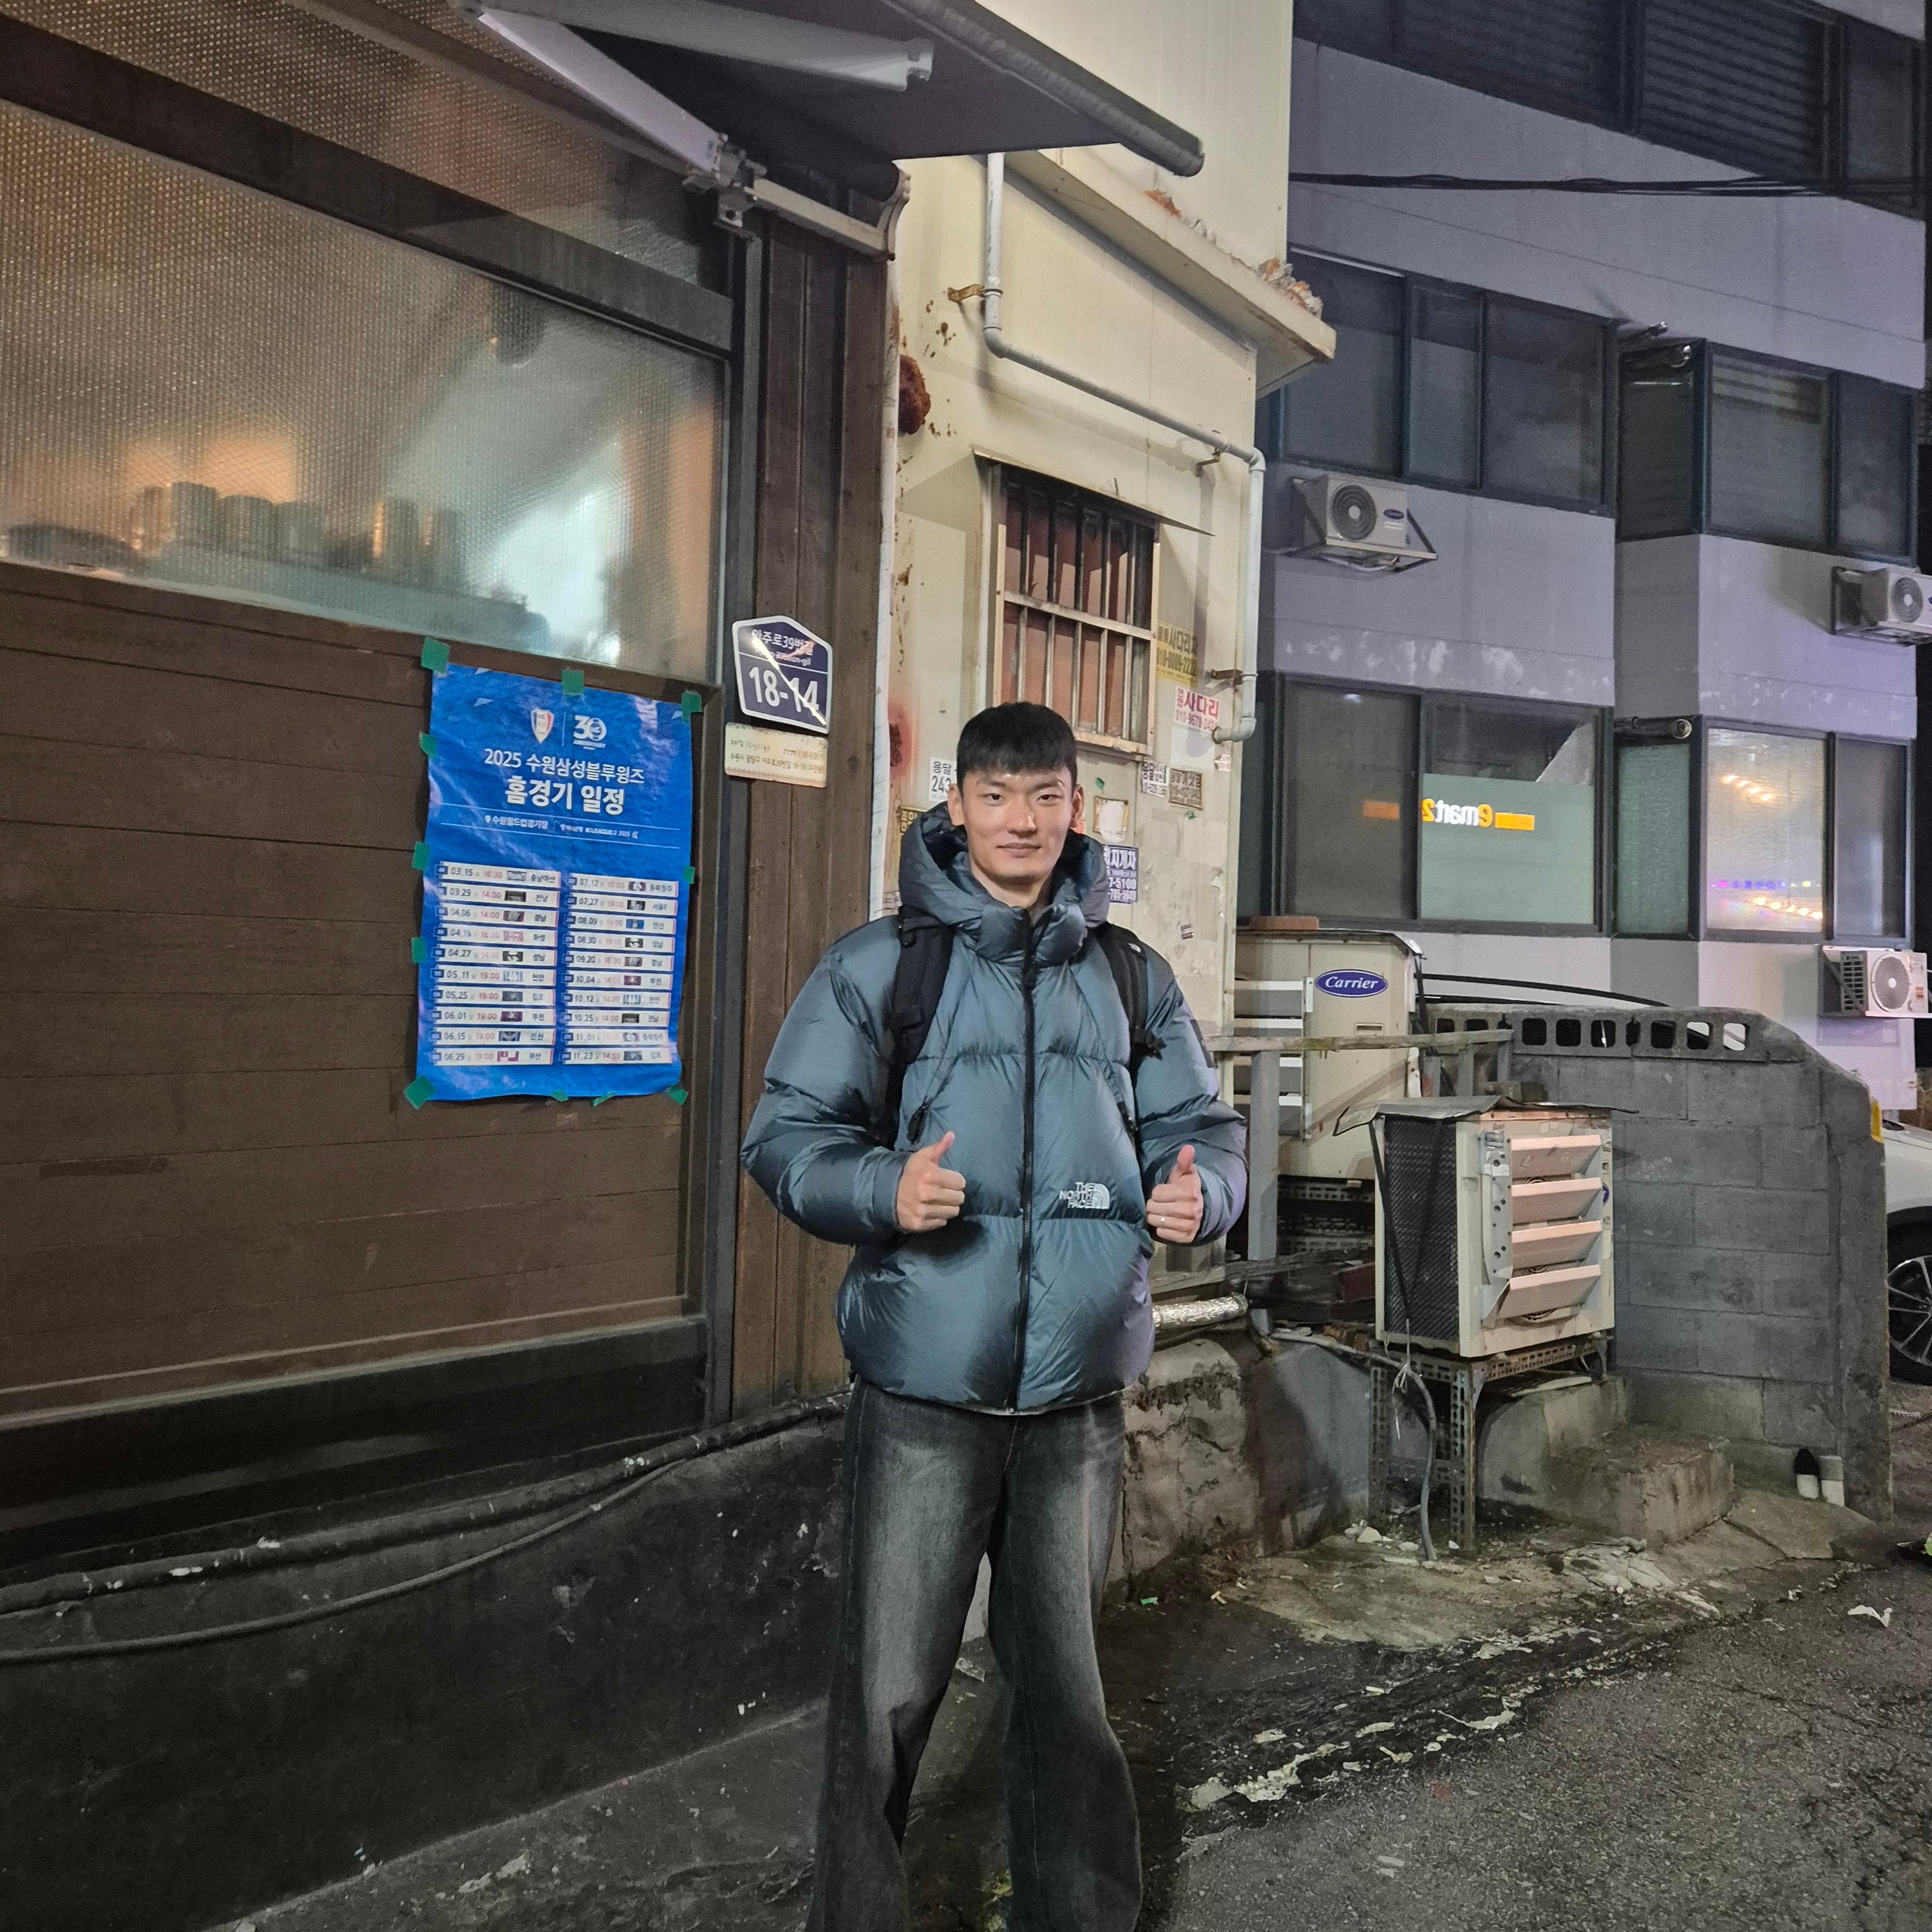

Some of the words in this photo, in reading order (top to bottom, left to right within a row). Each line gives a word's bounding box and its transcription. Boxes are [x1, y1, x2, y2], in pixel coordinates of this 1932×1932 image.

[749, 667, 819, 713] 18-14
[1184, 691, 1219, 719] 사다리
[484, 748, 522, 768] 2025
[526, 753, 645, 784] 수원삼성블루윙즈
[933, 761, 952, 775] 용달
[505, 775, 573, 810] 홈경기
[581, 786, 625, 815] 일정
[451, 867, 473, 876] 03.15
[484, 870, 502, 878] 16:30
[450, 887, 471, 896] 03.29
[482, 891, 501, 899] 14:00
[451, 928, 471, 937] 04.19
[448, 949, 471, 957] 04.27
[576, 955, 596, 963] 09.20
[447, 971, 469, 979] 05.11
[1325, 976, 1378, 989] Carrier
[1075, 1182, 1094, 1191] THE
[1059, 1190, 1092, 1200] NORTH
[1067, 1199, 1092, 1209] FACE
